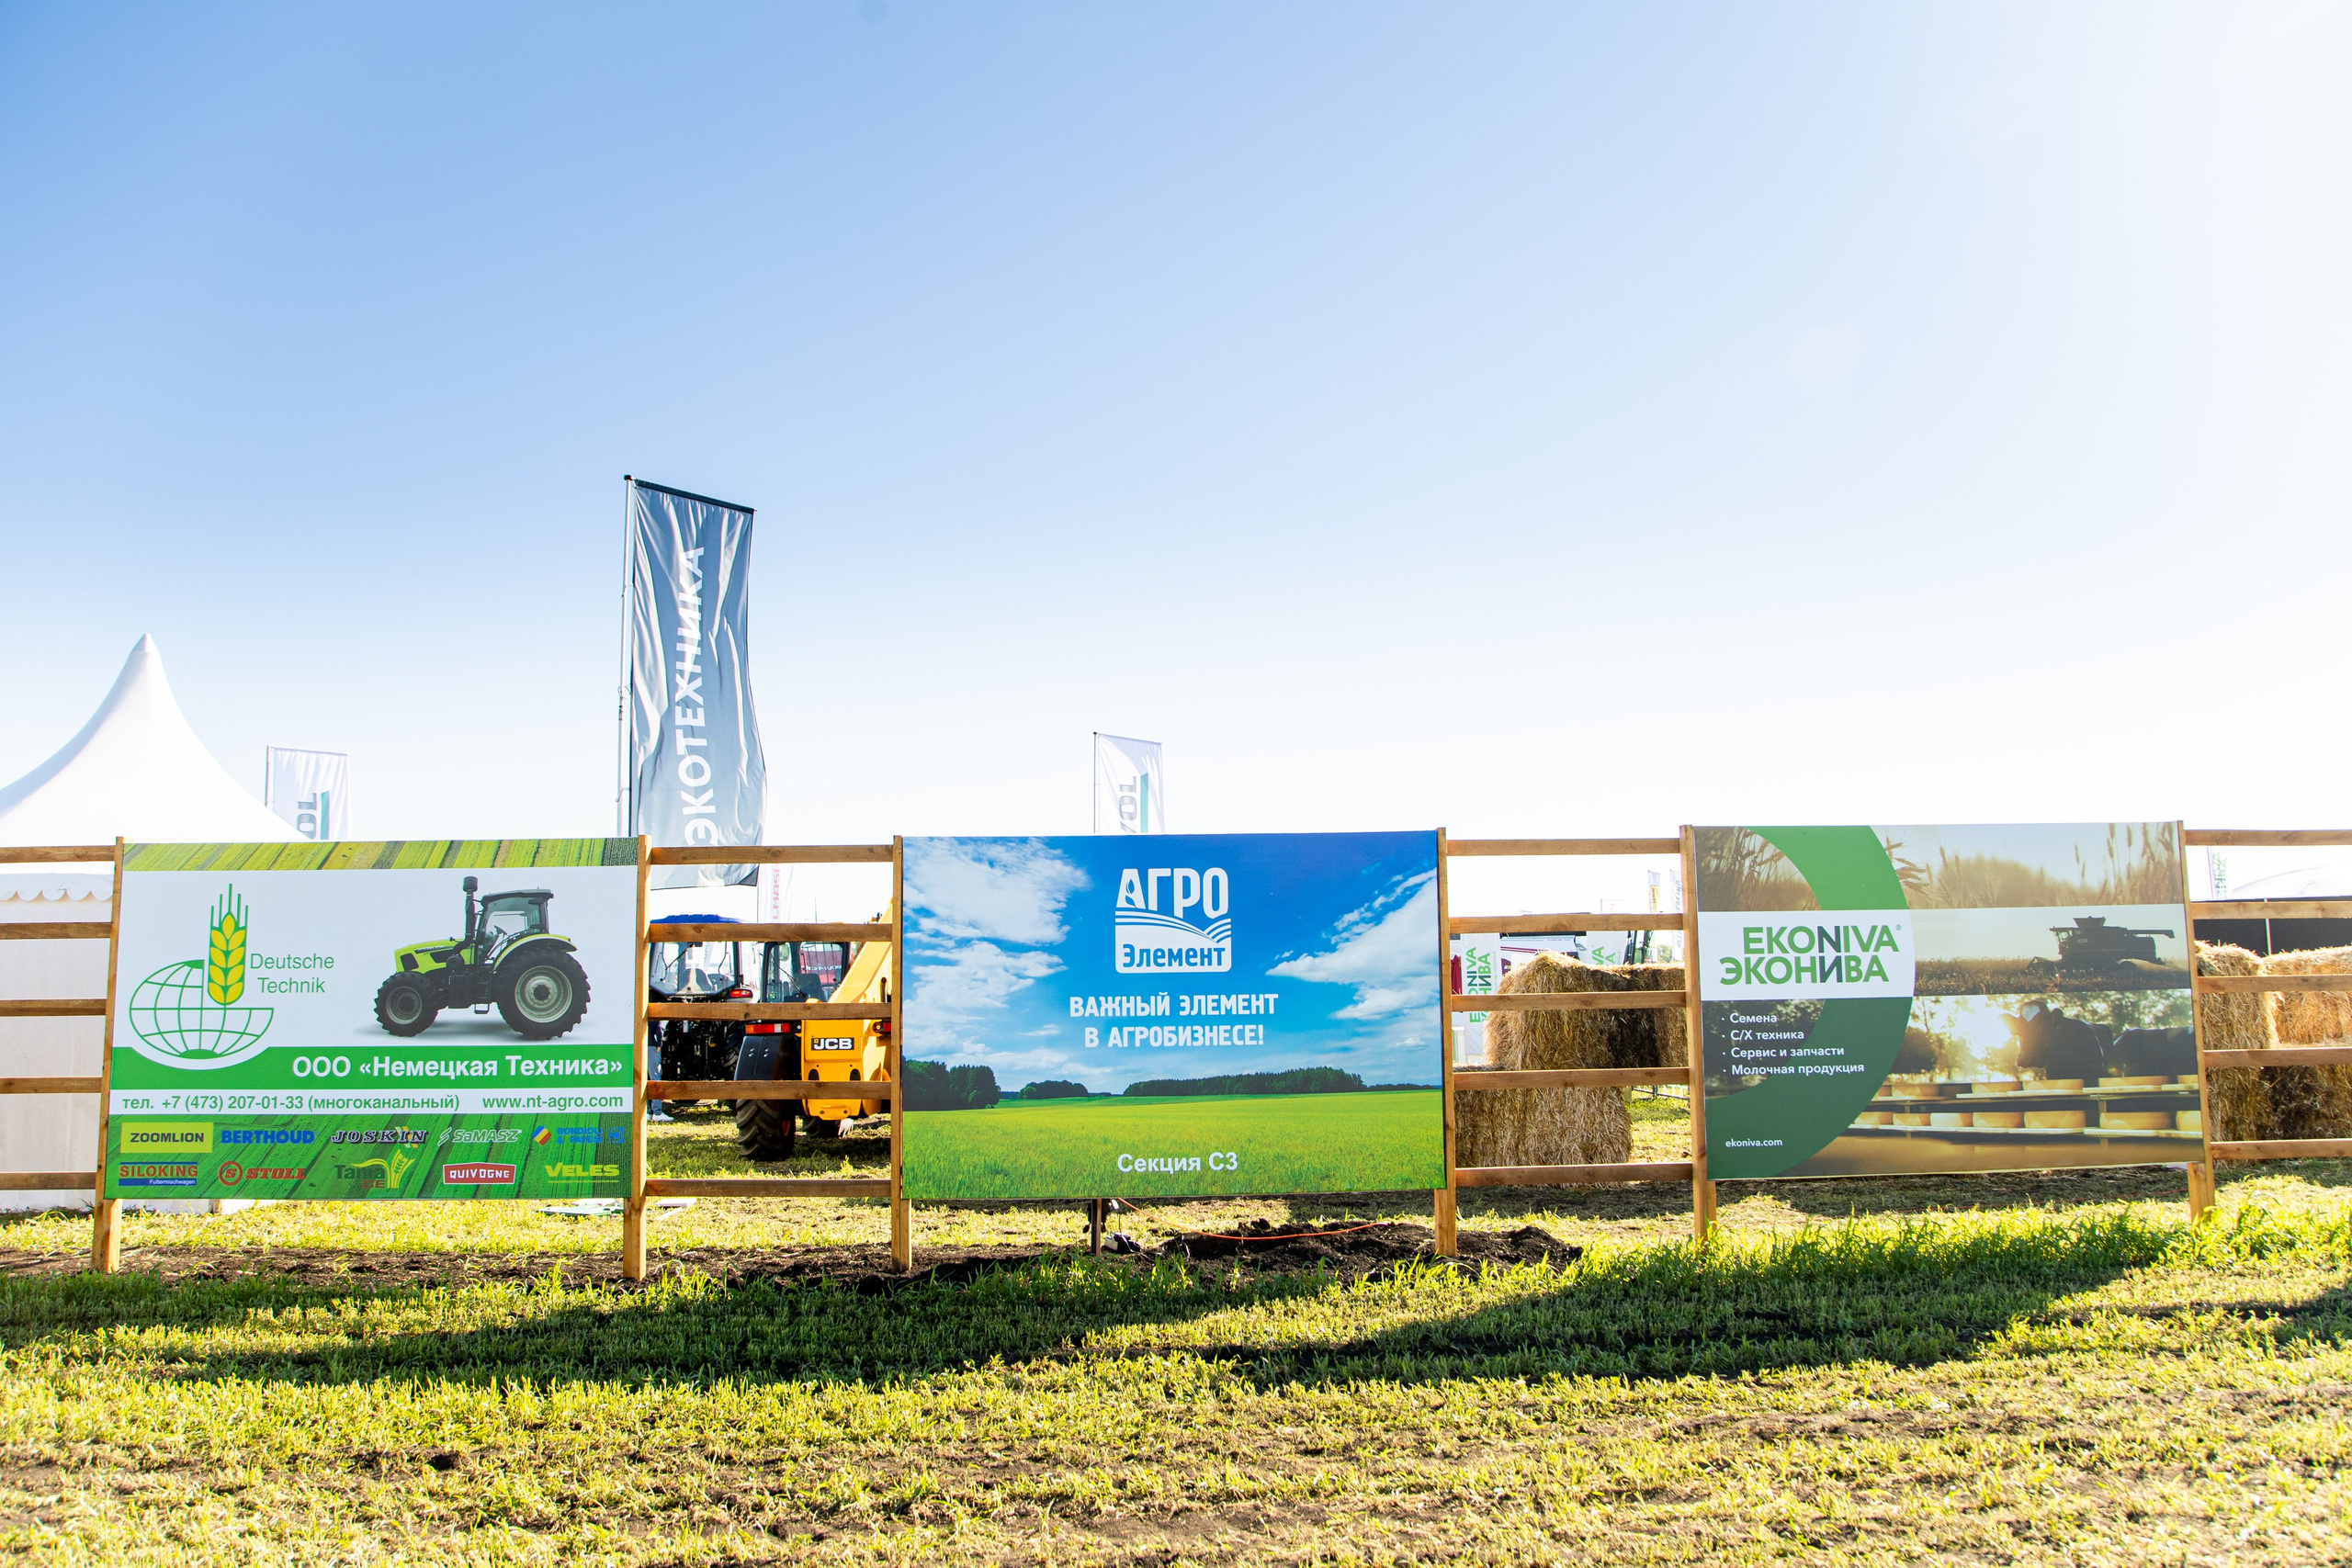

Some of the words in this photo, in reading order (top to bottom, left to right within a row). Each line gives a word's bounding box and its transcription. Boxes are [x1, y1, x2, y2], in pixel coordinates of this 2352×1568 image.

[674, 547, 718, 846] ЭКОТЕХНИКА
[1115, 867, 1229, 919] АГРО
[1743, 925, 1900, 954] EKONIVA
[250, 953, 334, 969] Deutsche
[1123, 943, 1226, 968] Элемент
[1719, 955, 1890, 986] ЭКОНИВА
[257, 977, 326, 993] Technik
[1465, 947, 1481, 1022] ENIVA
[1069, 992, 1170, 1017] ВАЖНЫЙ
[1179, 993, 1278, 1016] ЭЛЕМЕНТ
[1729, 1013, 1778, 1023] Семена
[1084, 1026, 1099, 1047] В
[1107, 1025, 1263, 1048] АГРОБИЗНЕСЕ!
[1730, 1030, 1753, 1041] С/Х
[1756, 1031, 1804, 1040] техника
[813, 1038, 852, 1050] JCB
[1731, 1047, 1777, 1060] Сервис
[1790, 1047, 1845, 1057] запчасти
[292, 1056, 351, 1077] ООО
[359, 1055, 498, 1080] «Немецкая
[505, 1055, 623, 1077] Техника»
[1731, 1065, 1795, 1076] Молочная
[1798, 1065, 1865, 1077] продукция
[122, 1098, 154, 1109] тел.
[162, 1096, 181, 1109] +7
[185, 1095, 224, 1112] (473)
[228, 1096, 304, 1110] 207-01-33
[308, 1094, 460, 1111] (многоканальный)
[482, 1094, 624, 1111] www.nt-agro.com
[130, 1132, 205, 1143] ZOOMLION
[221, 1130, 315, 1144] BERTHOUD
[331, 1130, 429, 1144] JOSKIN
[452, 1129, 520, 1143] SaMASZ
[557, 1127, 603, 1135] BONDIOLI
[570, 1135, 603, 1144] PAVESI
[1724, 1137, 1783, 1147] ekoniva.com
[119, 1165, 198, 1178] SILOKING
[334, 1165, 386, 1179] Tama
[545, 1162, 620, 1177] VELES
[1117, 1154, 1201, 1176] Секция
[244, 1168, 307, 1179] STOLL
[449, 1168, 510, 1179] QUIVOGNE
